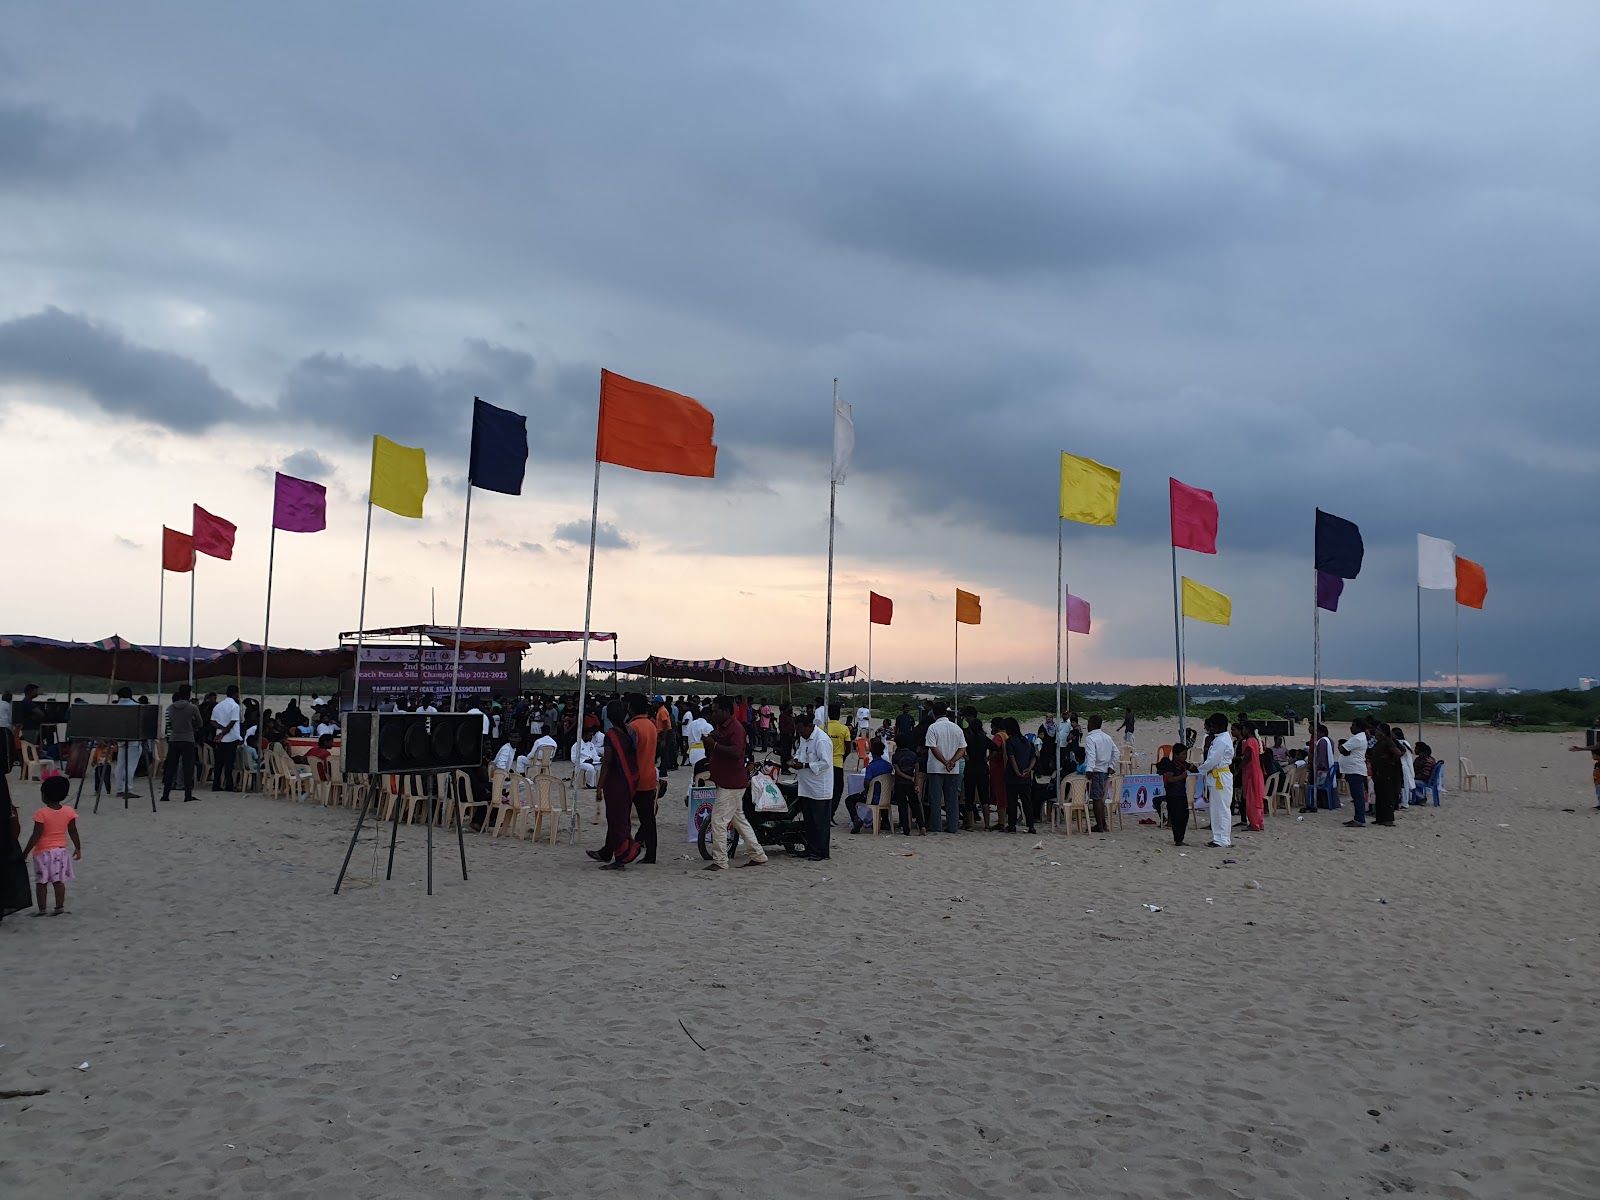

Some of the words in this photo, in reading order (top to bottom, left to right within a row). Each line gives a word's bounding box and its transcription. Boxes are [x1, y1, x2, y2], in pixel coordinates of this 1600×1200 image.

[403, 662, 418, 670] 2nd
[420, 662, 443, 671] South
[444, 663, 464, 671] Zoe
[422, 671, 471, 680] Champioship
[472, 671, 508, 679] 2022-2023
